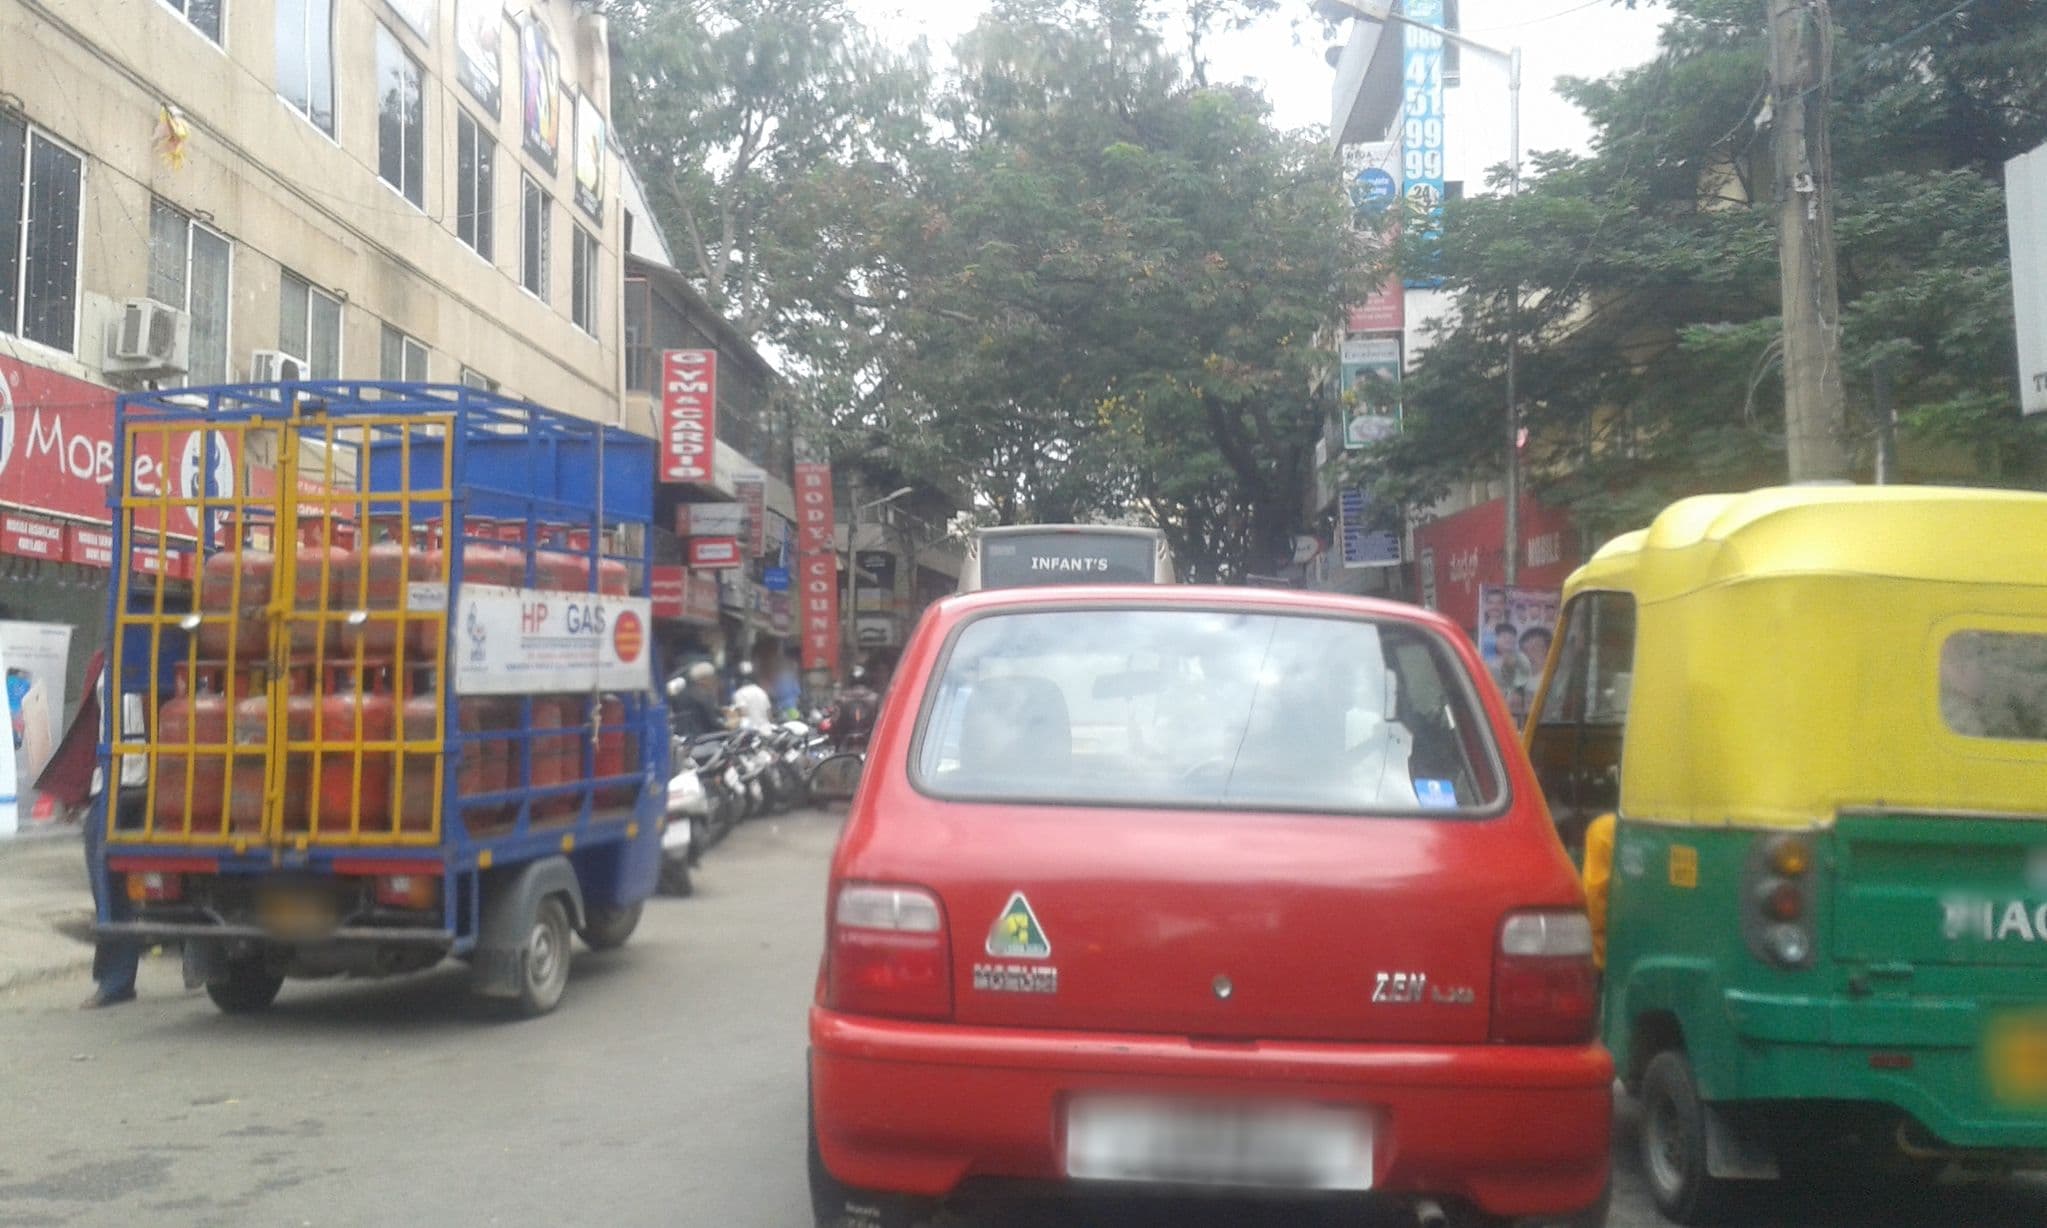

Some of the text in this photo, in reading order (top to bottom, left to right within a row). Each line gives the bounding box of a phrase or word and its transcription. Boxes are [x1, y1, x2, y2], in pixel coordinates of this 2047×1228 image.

[1405, 118, 1442, 149] 99
[1405, 150, 1442, 180] 99
[1031, 556, 1108, 572] INFANT'S
[521, 602, 549, 634] HP
[567, 603, 606, 635] GAS
